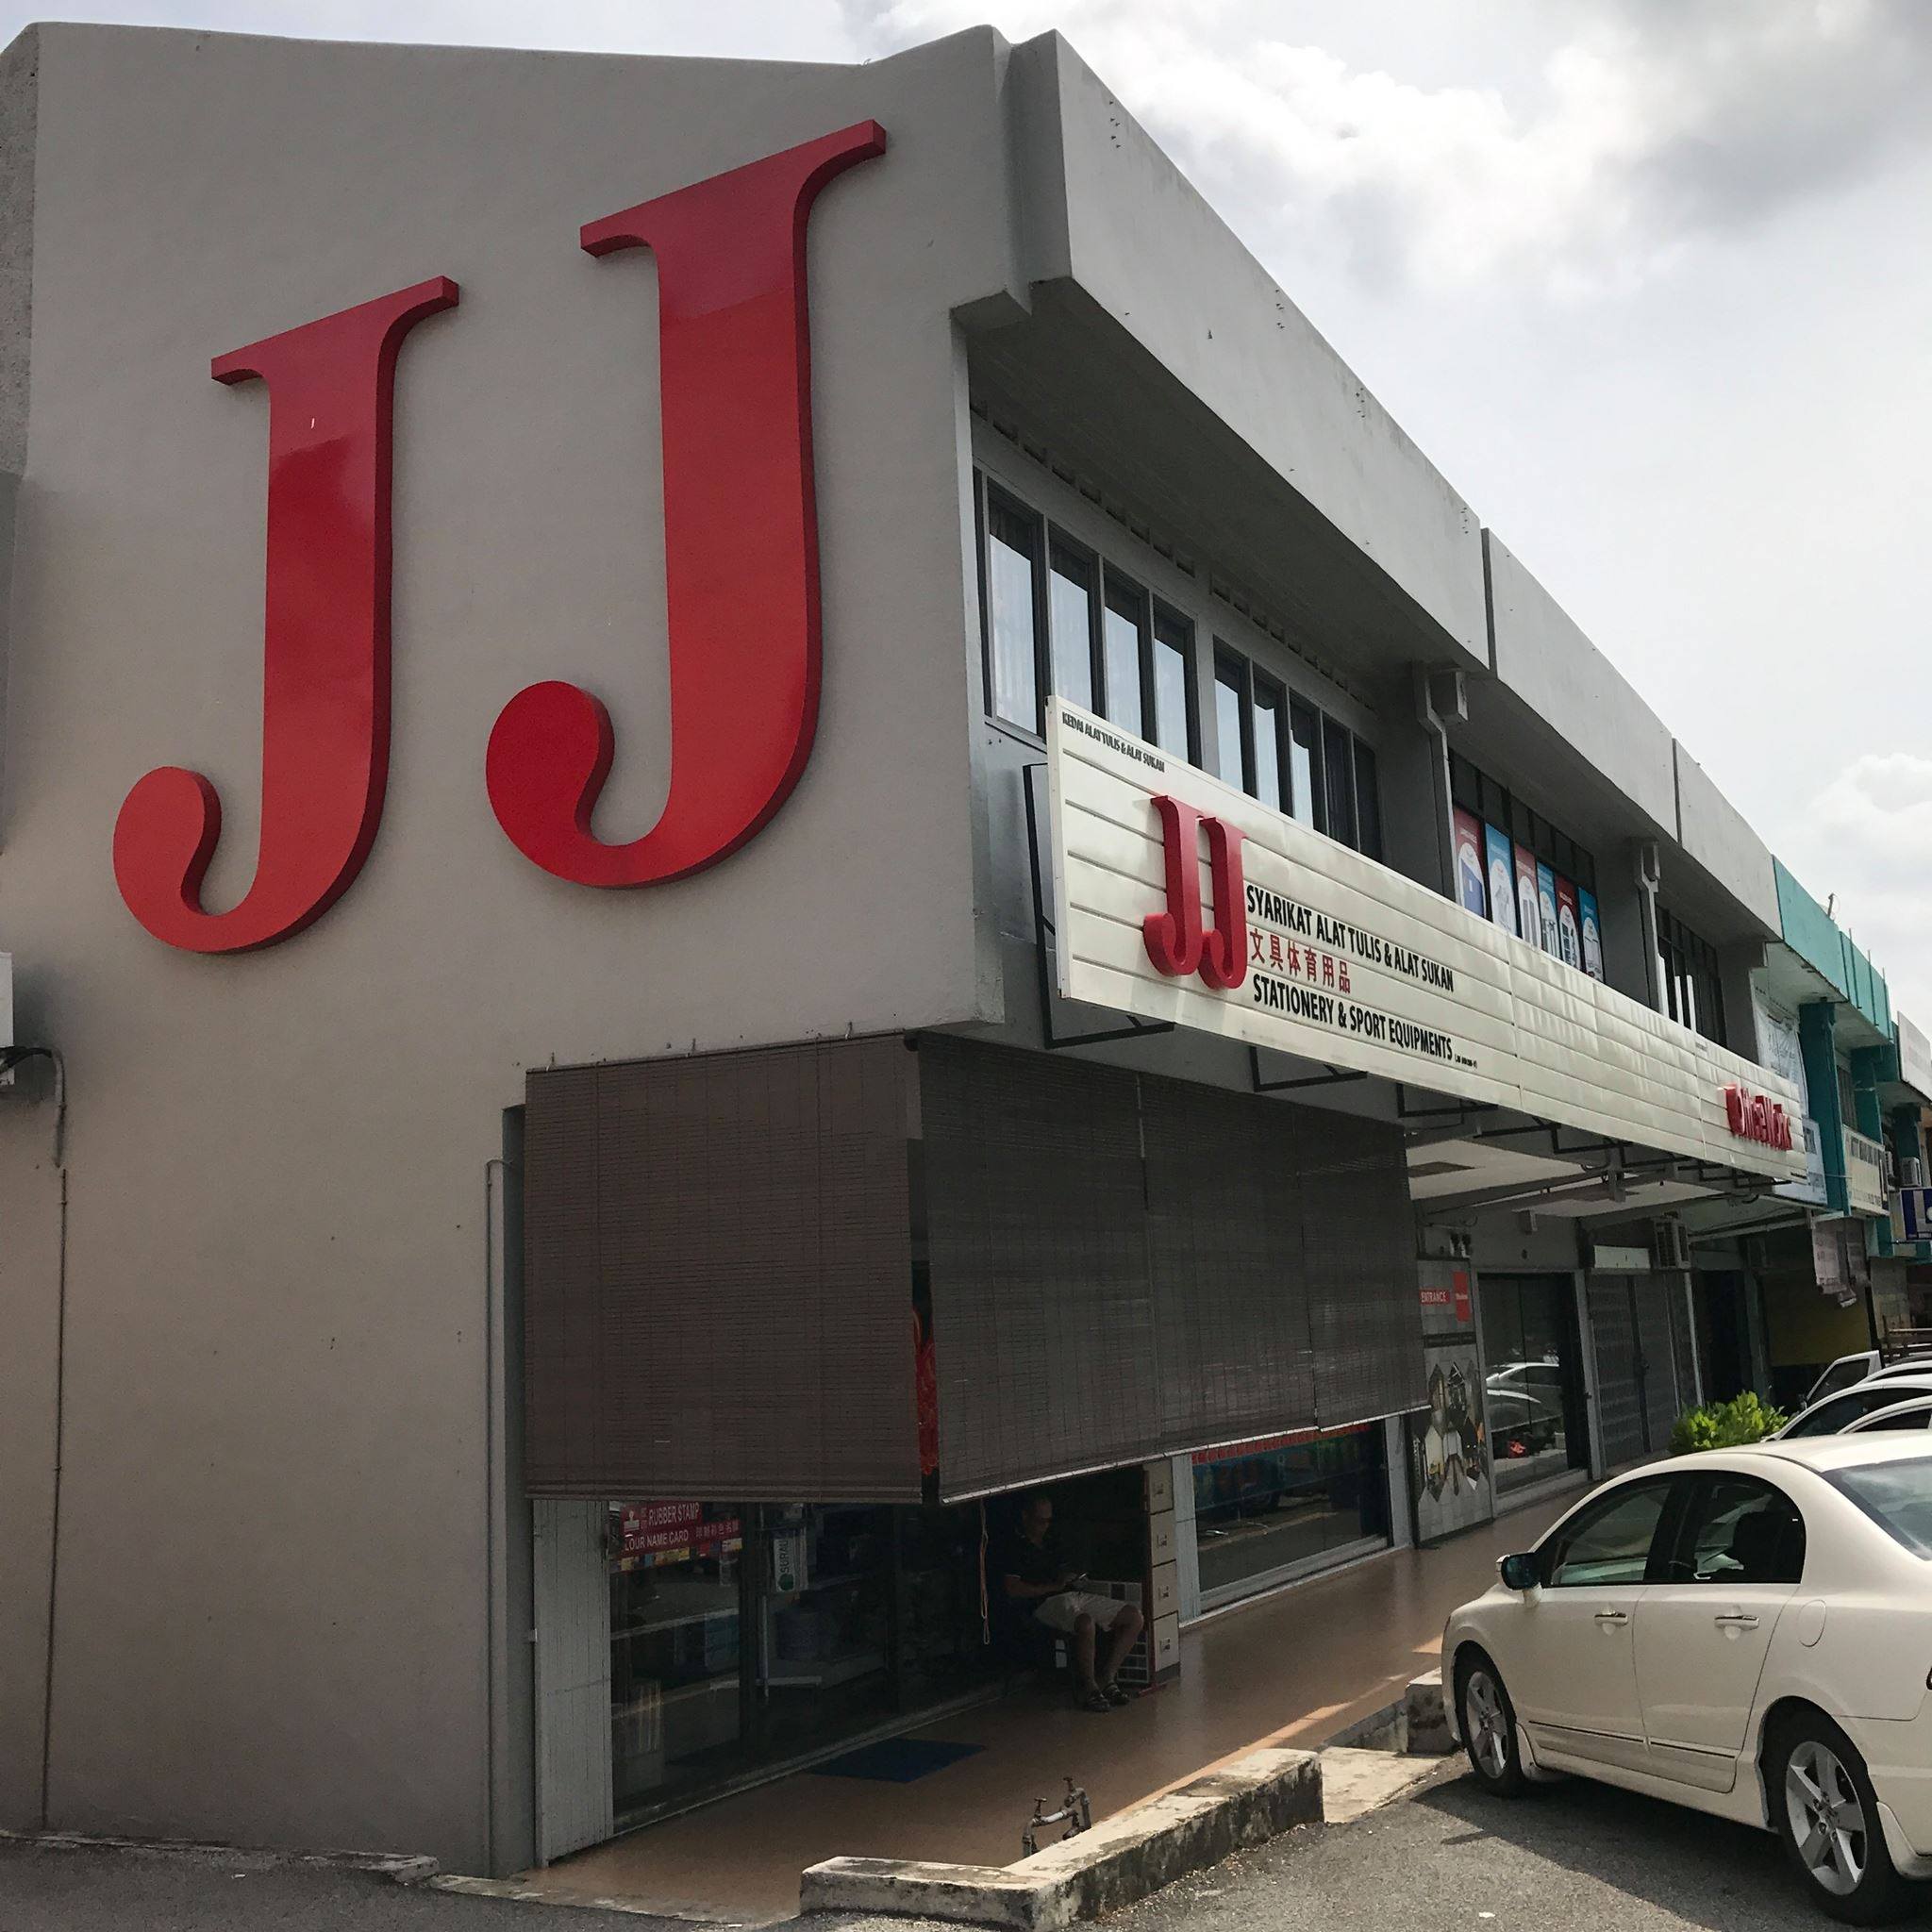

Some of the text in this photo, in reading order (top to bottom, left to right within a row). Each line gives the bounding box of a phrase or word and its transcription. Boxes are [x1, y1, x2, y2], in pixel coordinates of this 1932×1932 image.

[1062, 711, 1165, 773] KEDAI ALAT TULIS & ALAT SUKAN
[1143, 795, 1249, 990] JJ
[1246, 885, 1454, 992] SYARIKAT ALAT TULIS & ALAT SUKAN
[1250, 928, 1351, 993] 文具体育用品
[1253, 974, 1453, 1060] STATIONERY & SPORT EQUIPMENTS
[1421, 1290, 1447, 1304] ENTRANCE
[646, 1533, 669, 1549] NAME
[669, 1528, 690, 1546] CARD
[648, 1505, 677, 1526] RUBBER
[677, 1502, 700, 1523] STAMP
